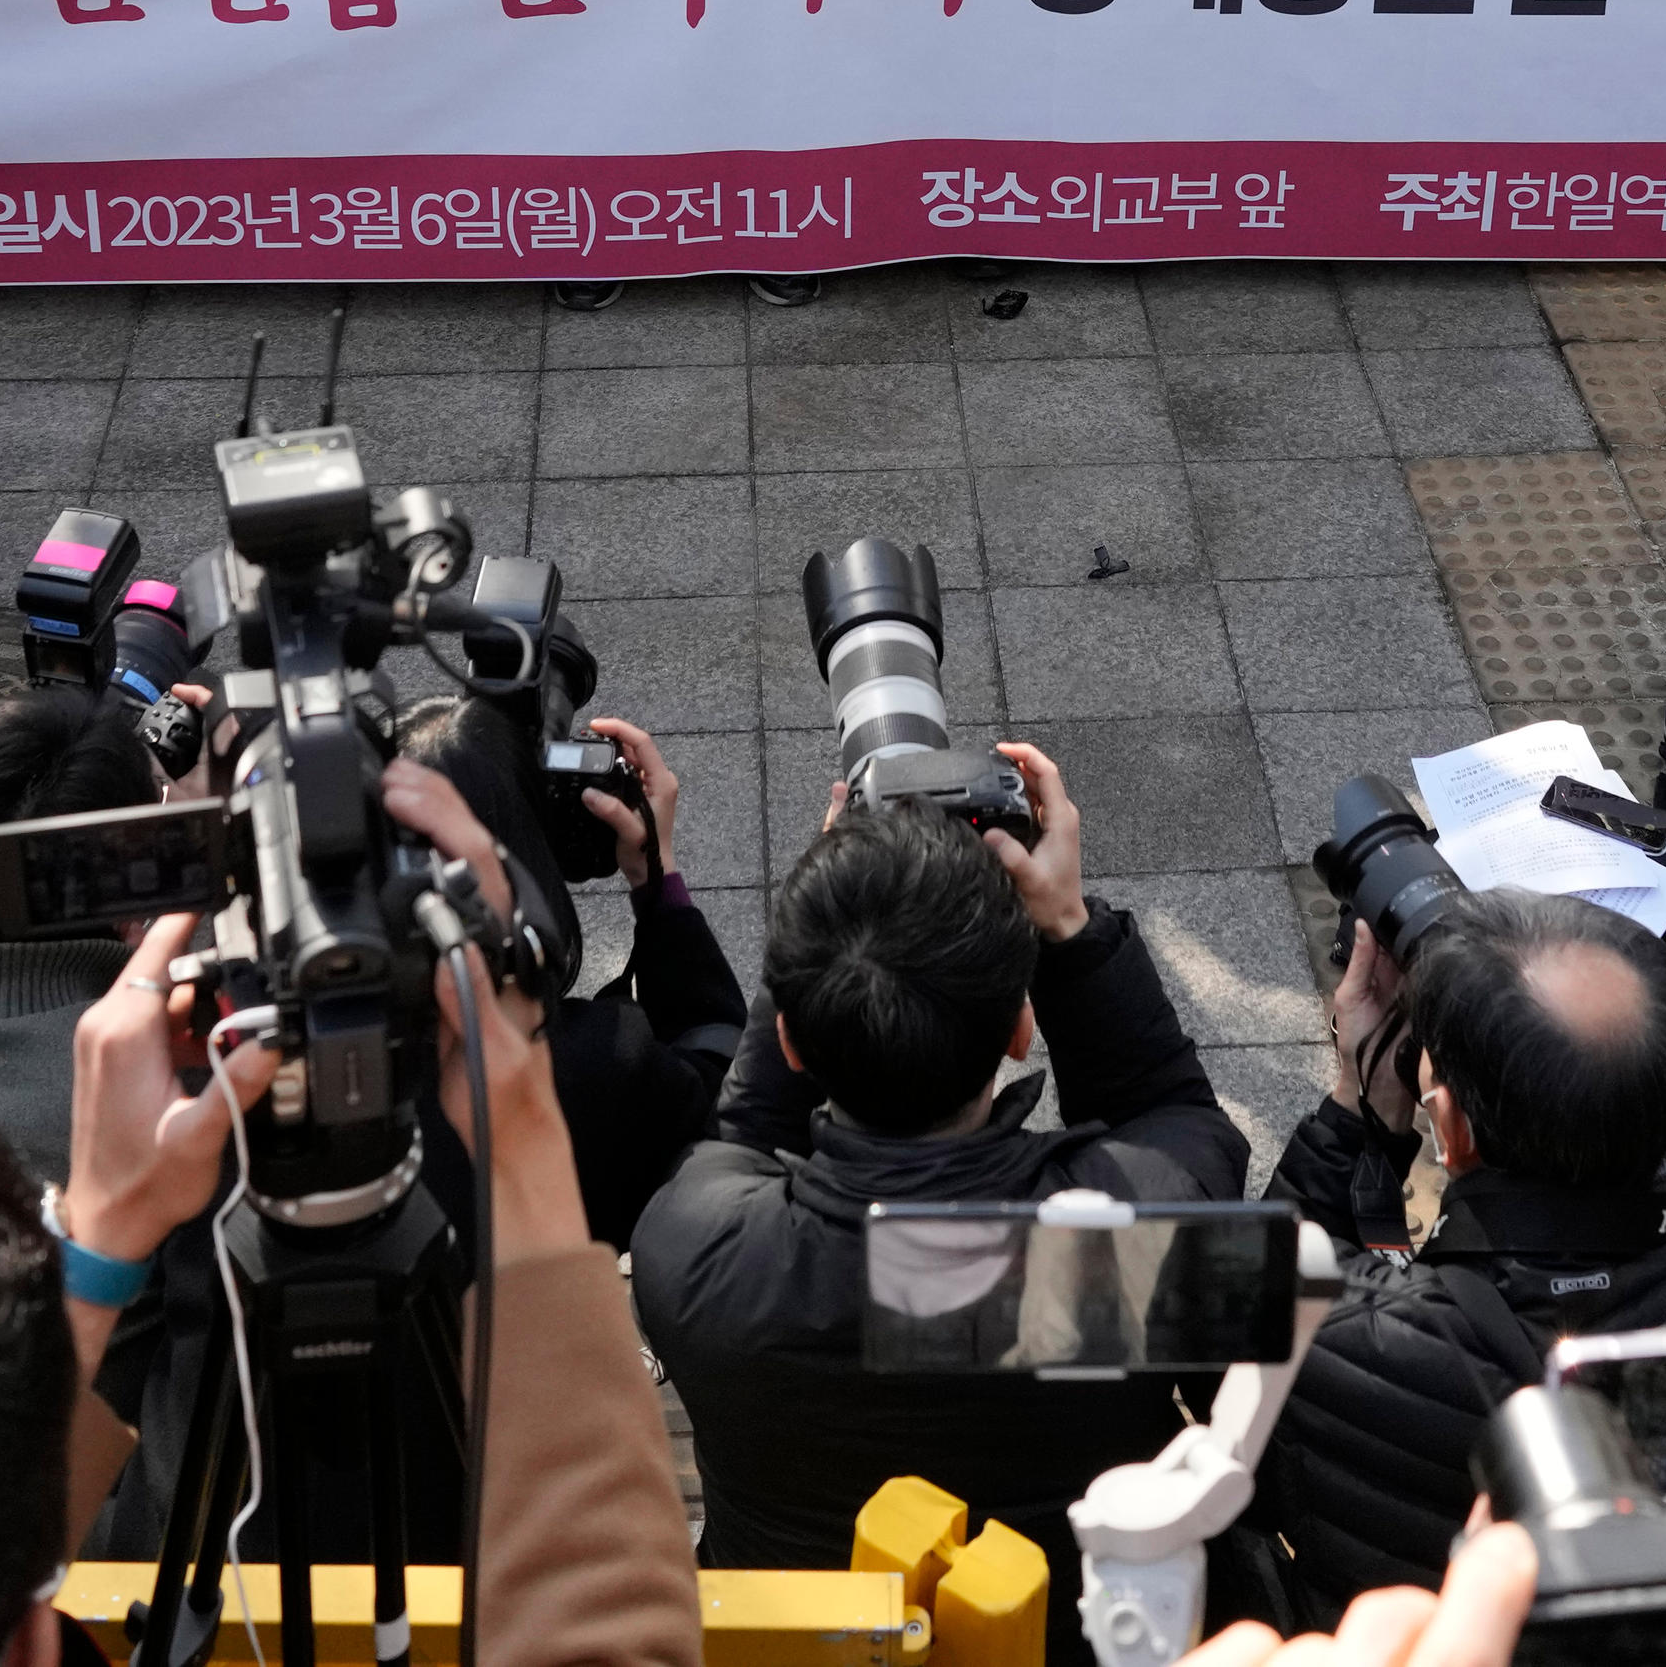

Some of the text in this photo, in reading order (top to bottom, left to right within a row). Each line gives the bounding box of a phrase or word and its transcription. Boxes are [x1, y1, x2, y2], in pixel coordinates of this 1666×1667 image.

[108, 188, 301, 248] 2023년
[310, 187, 402, 249] 3월
[411, 187, 596, 257] 6일(월)
[605, 182, 722, 244] 오전
[735, 177, 851, 238] 11시
[920, 168, 1295, 232] 장소 외교부 앞
[1380, 171, 1497, 231] 주최
